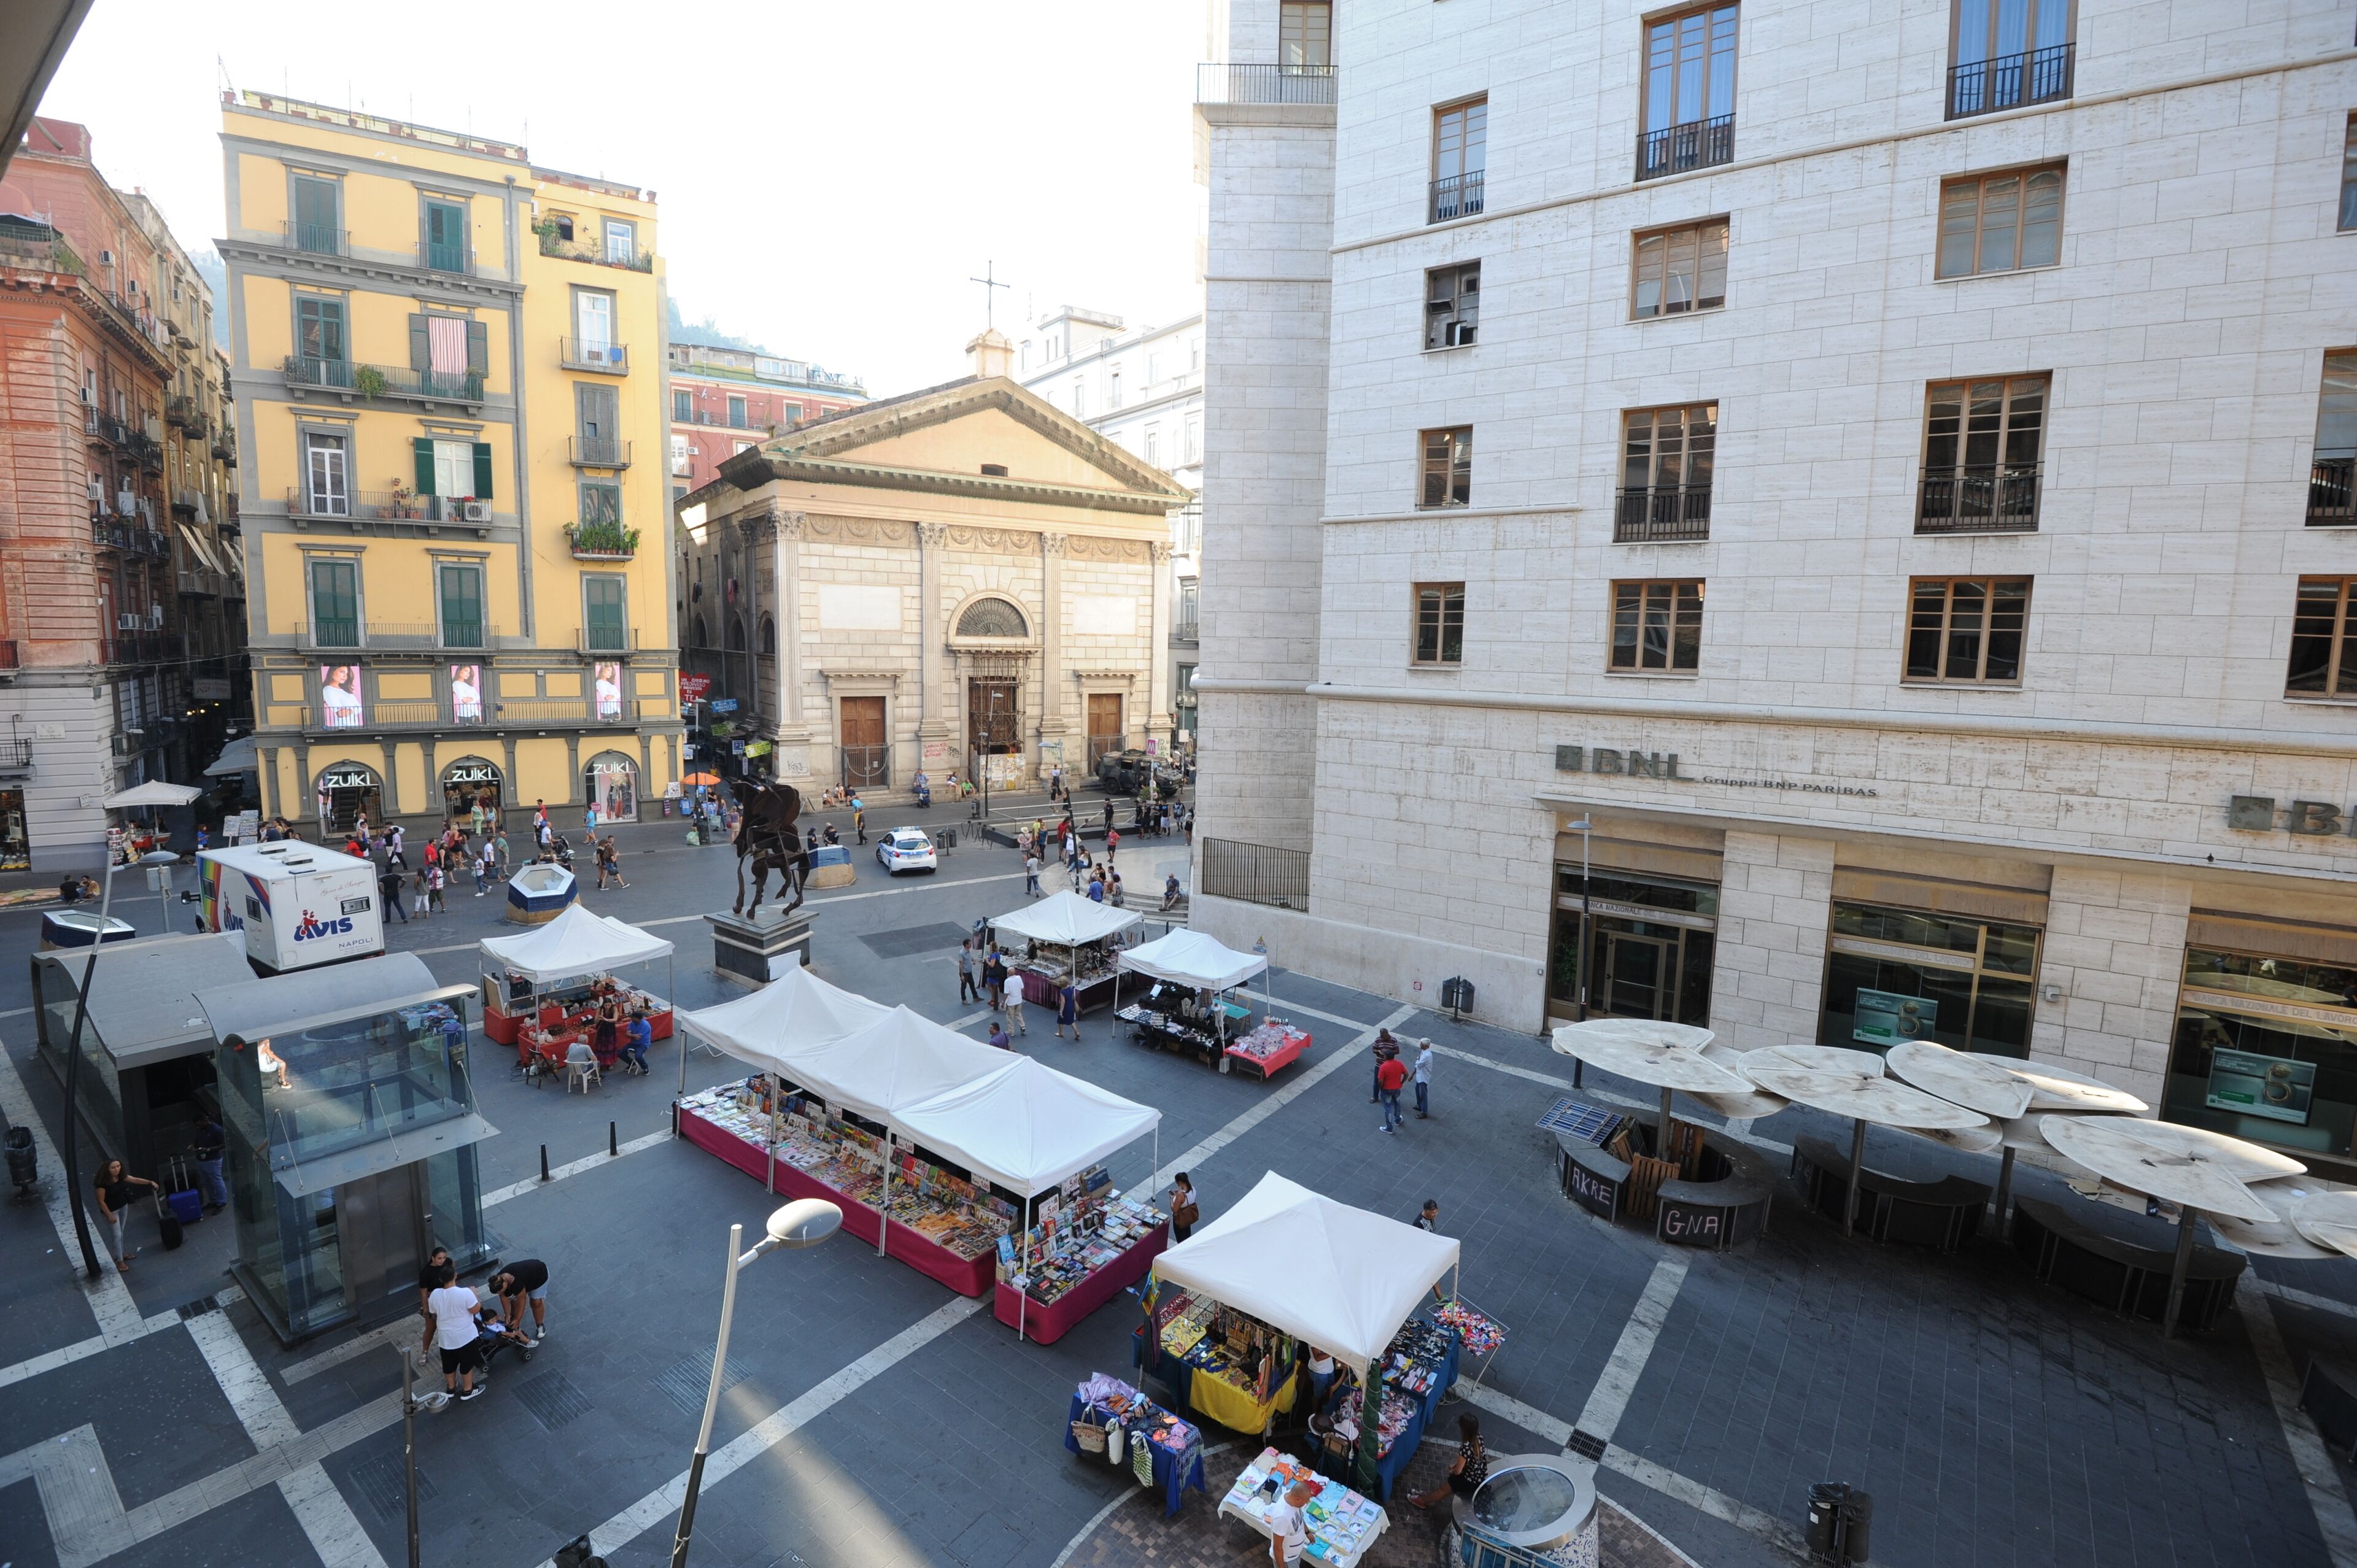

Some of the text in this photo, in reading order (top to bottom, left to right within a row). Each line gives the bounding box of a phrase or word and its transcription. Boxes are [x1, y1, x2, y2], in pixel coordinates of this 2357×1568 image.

[1592, 747, 1878, 798] BNL Gruppo BNP PARIBAS
[2289, 800, 2357, 840] B
[1606, 905, 1641, 915] NAZIONALE
[294, 917, 353, 941] AVIS
[339, 937, 373, 948] NAPOLI
[1916, 951, 1931, 960] DEL
[1935, 954, 1968, 967] LAVORO
[2194, 992, 2227, 1006] BANCA
[2231, 997, 2289, 1015] NAZIONALE
[2293, 1006, 2313, 1018] DEL
[1572, 1166, 1611, 1205] AKRE
[1666, 1210, 1719, 1235] GNA
